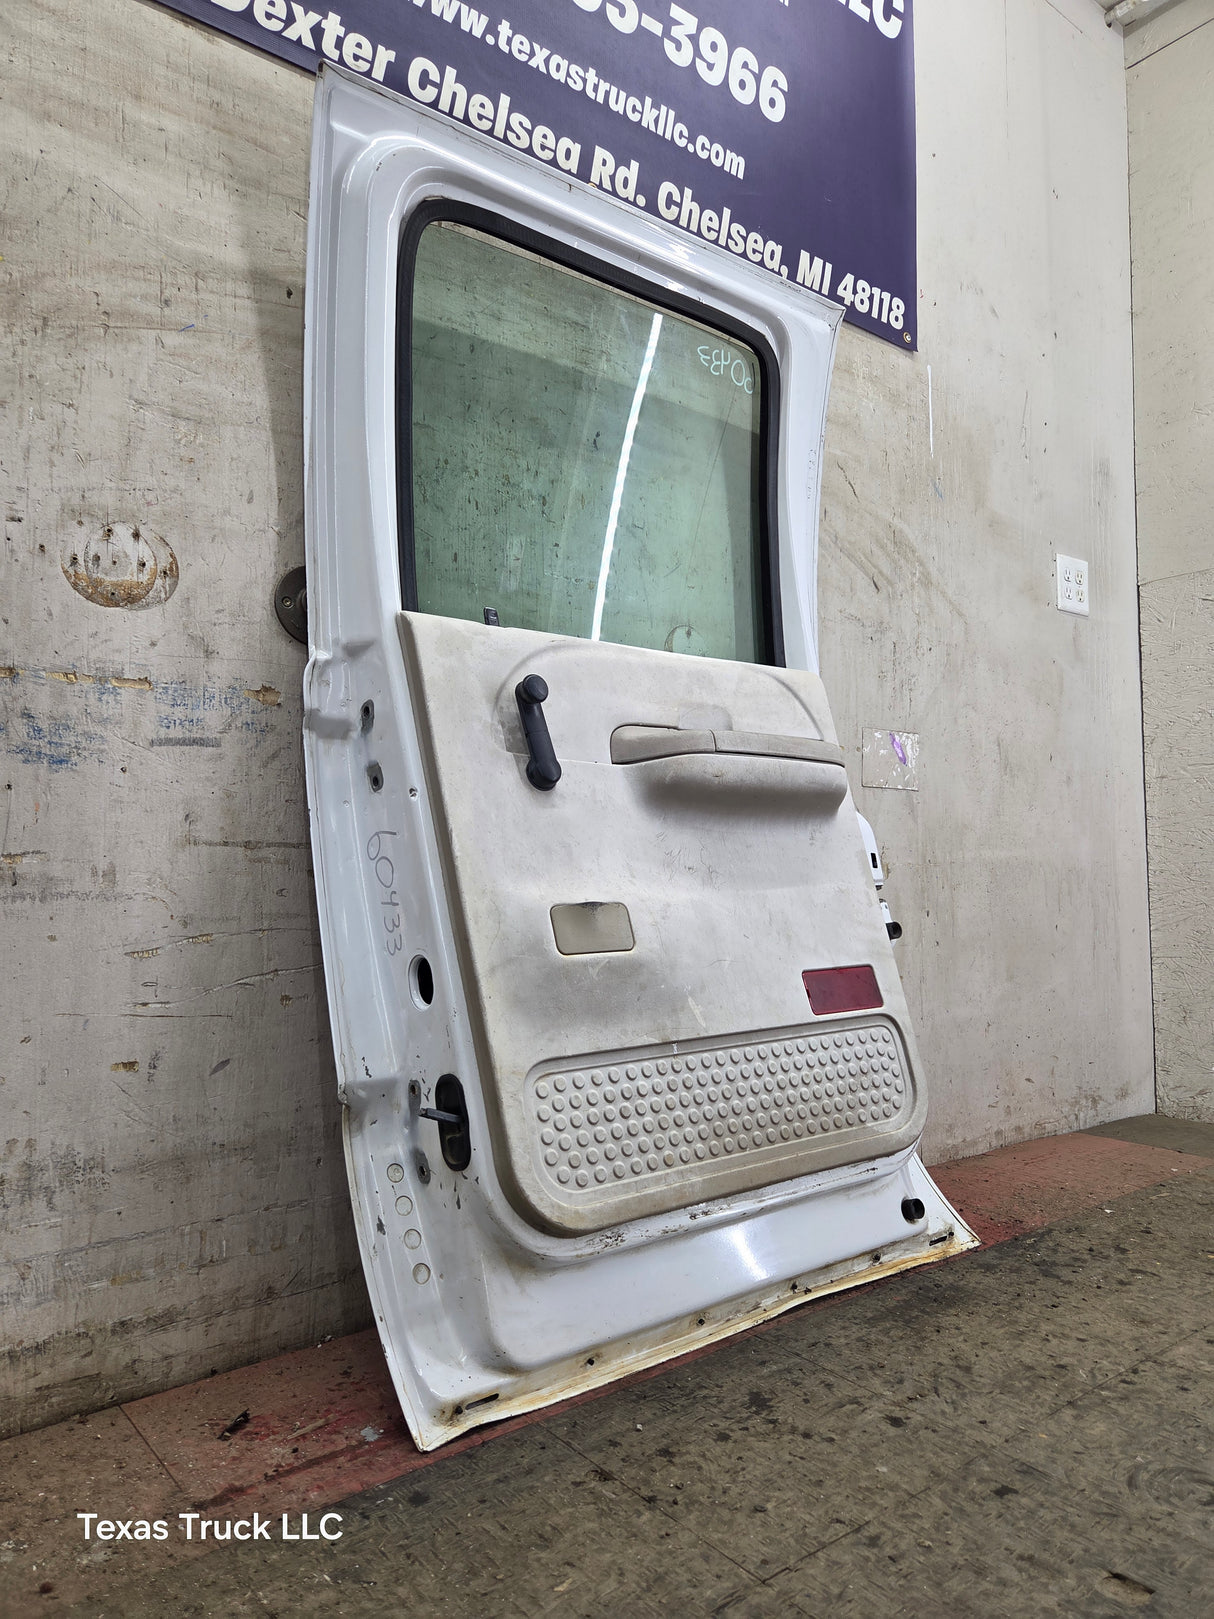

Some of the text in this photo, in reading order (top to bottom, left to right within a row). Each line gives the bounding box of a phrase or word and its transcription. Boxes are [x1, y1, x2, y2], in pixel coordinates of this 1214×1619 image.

[210, 0, 906, 330] exter Chelsea Rd. Chelsea, MI 48118
[406, 0, 746, 180] ww.texastruckllc.com
[367, 831, 403, 957] 60433
